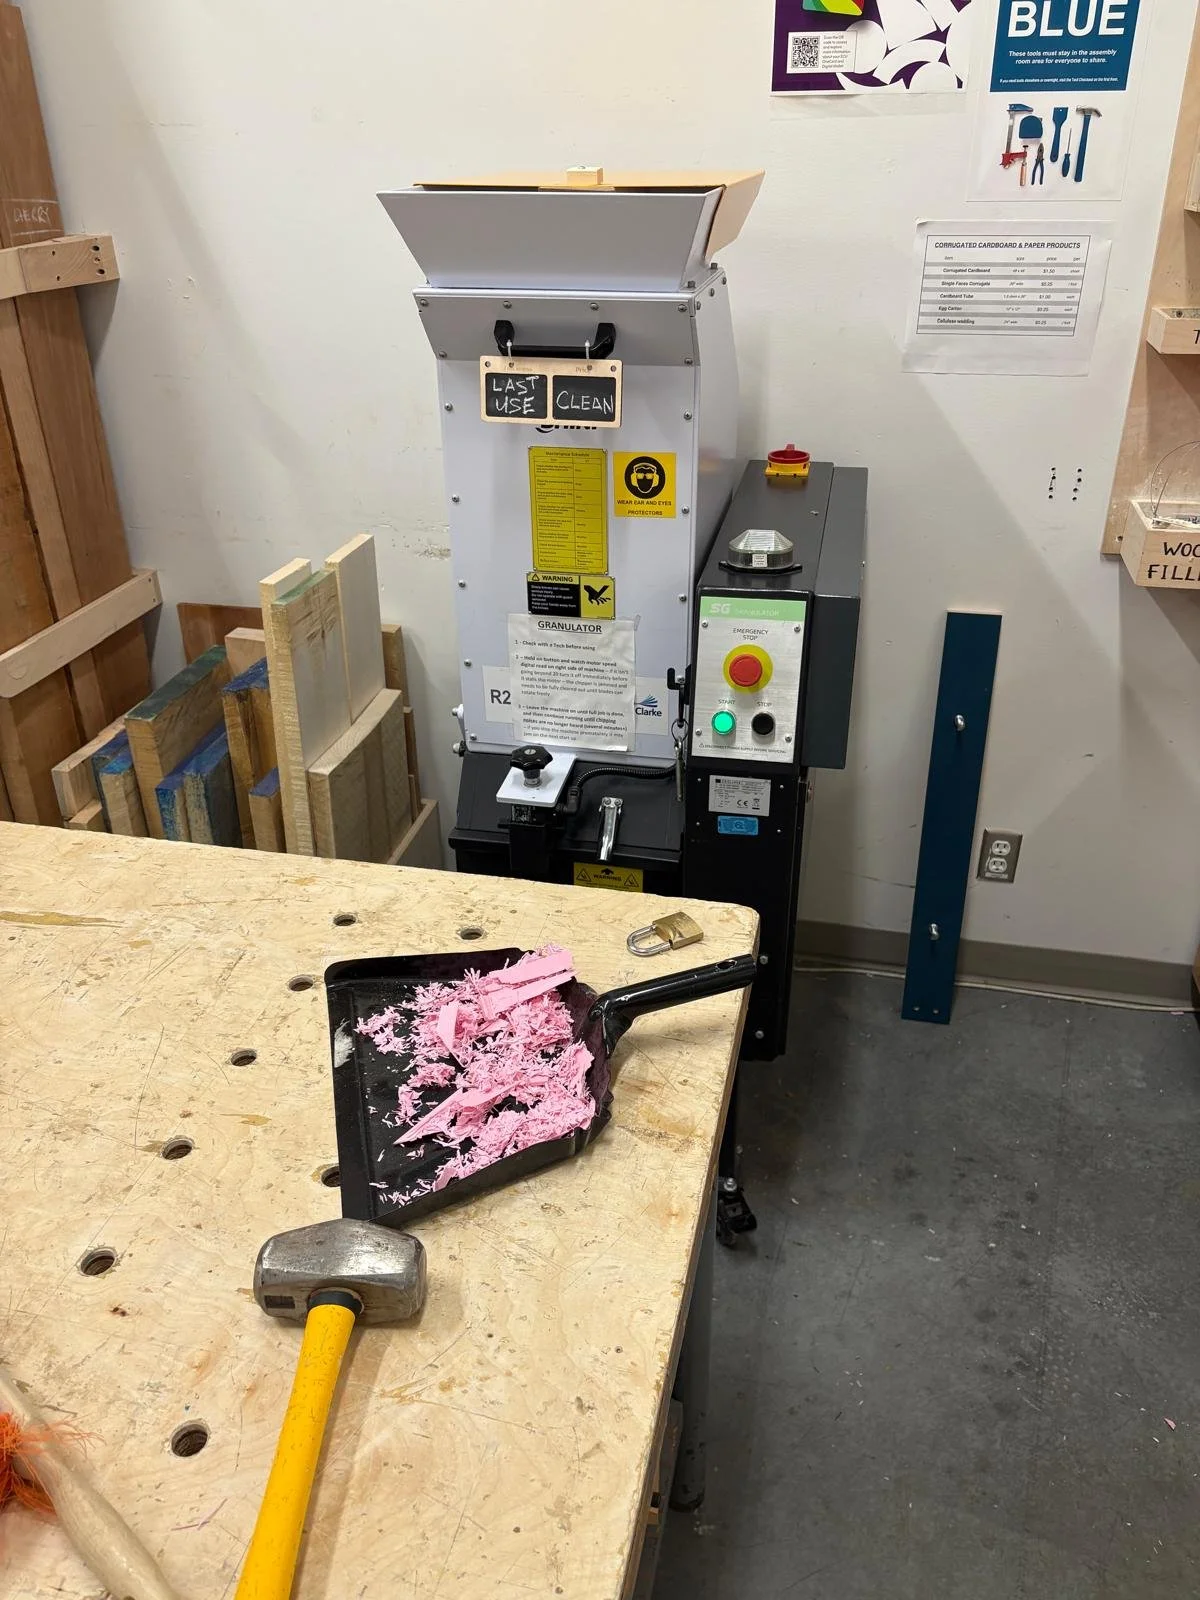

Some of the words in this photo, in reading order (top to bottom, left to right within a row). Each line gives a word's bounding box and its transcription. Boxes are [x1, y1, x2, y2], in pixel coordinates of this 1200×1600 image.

[1007, 0, 1129, 38] BLUE
[492, 375, 540, 396] LAST
[495, 396, 535, 415] USE
[556, 390, 614, 415] CLEAN
[1148, 564, 1200, 581] FILL
[710, 603, 732, 614] SG
[538, 620, 602, 633] GRANULATOR
[491, 689, 512, 705] R2
[635, 707, 662, 717] Clarke
